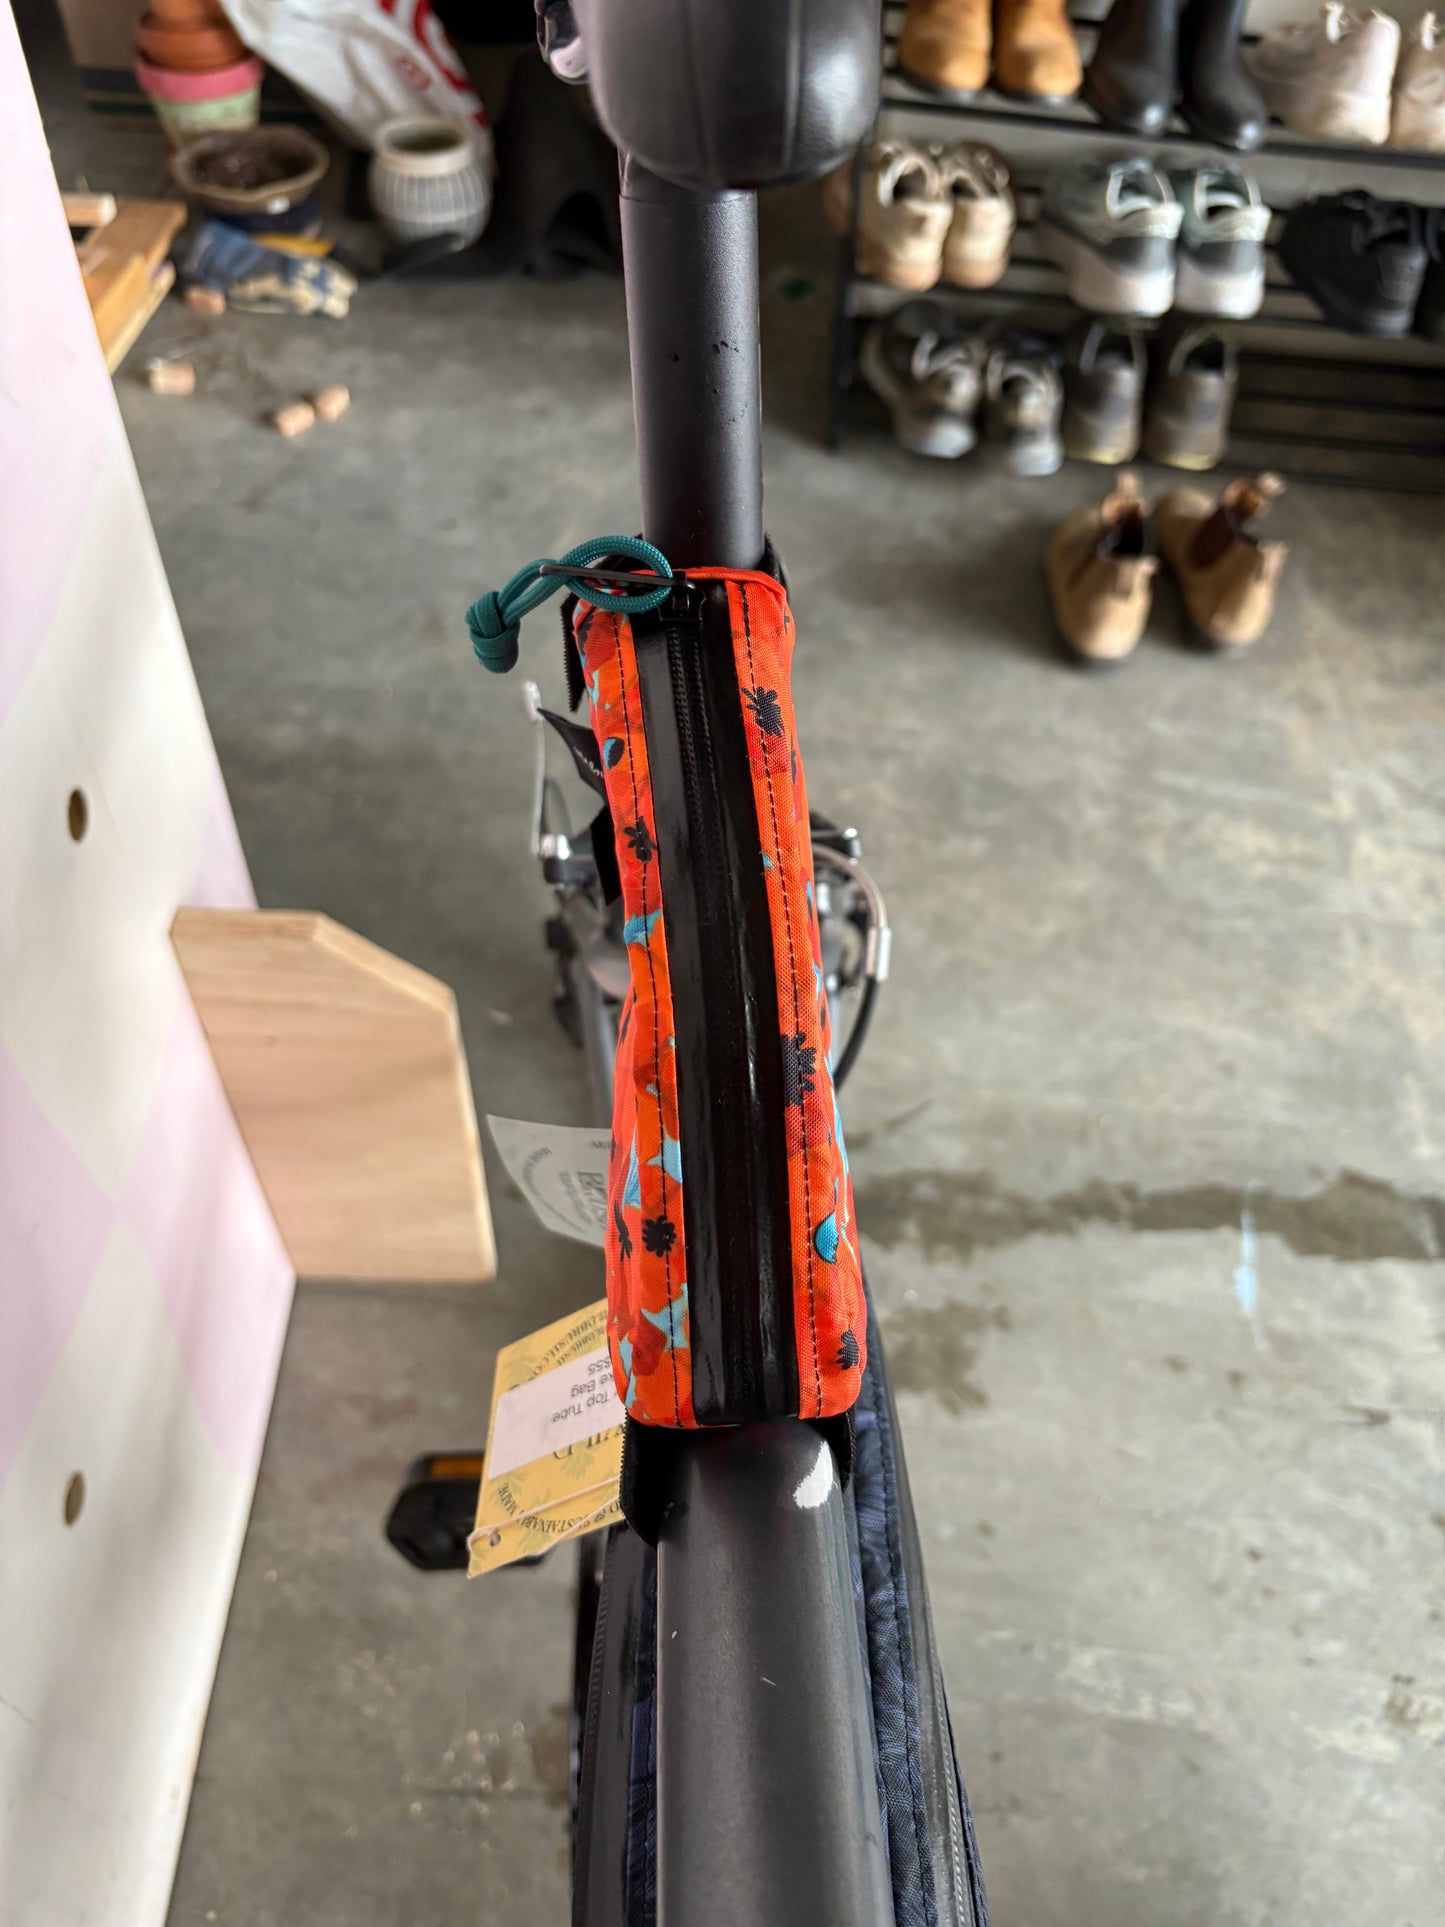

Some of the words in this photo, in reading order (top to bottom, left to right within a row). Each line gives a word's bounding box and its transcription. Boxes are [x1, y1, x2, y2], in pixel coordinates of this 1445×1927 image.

[570, 1380, 596, 1397] Bag
[587, 1391, 609, 1408] Top
[552, 1407, 583, 1424] Tube
[498, 1482, 516, 1516] MADE
